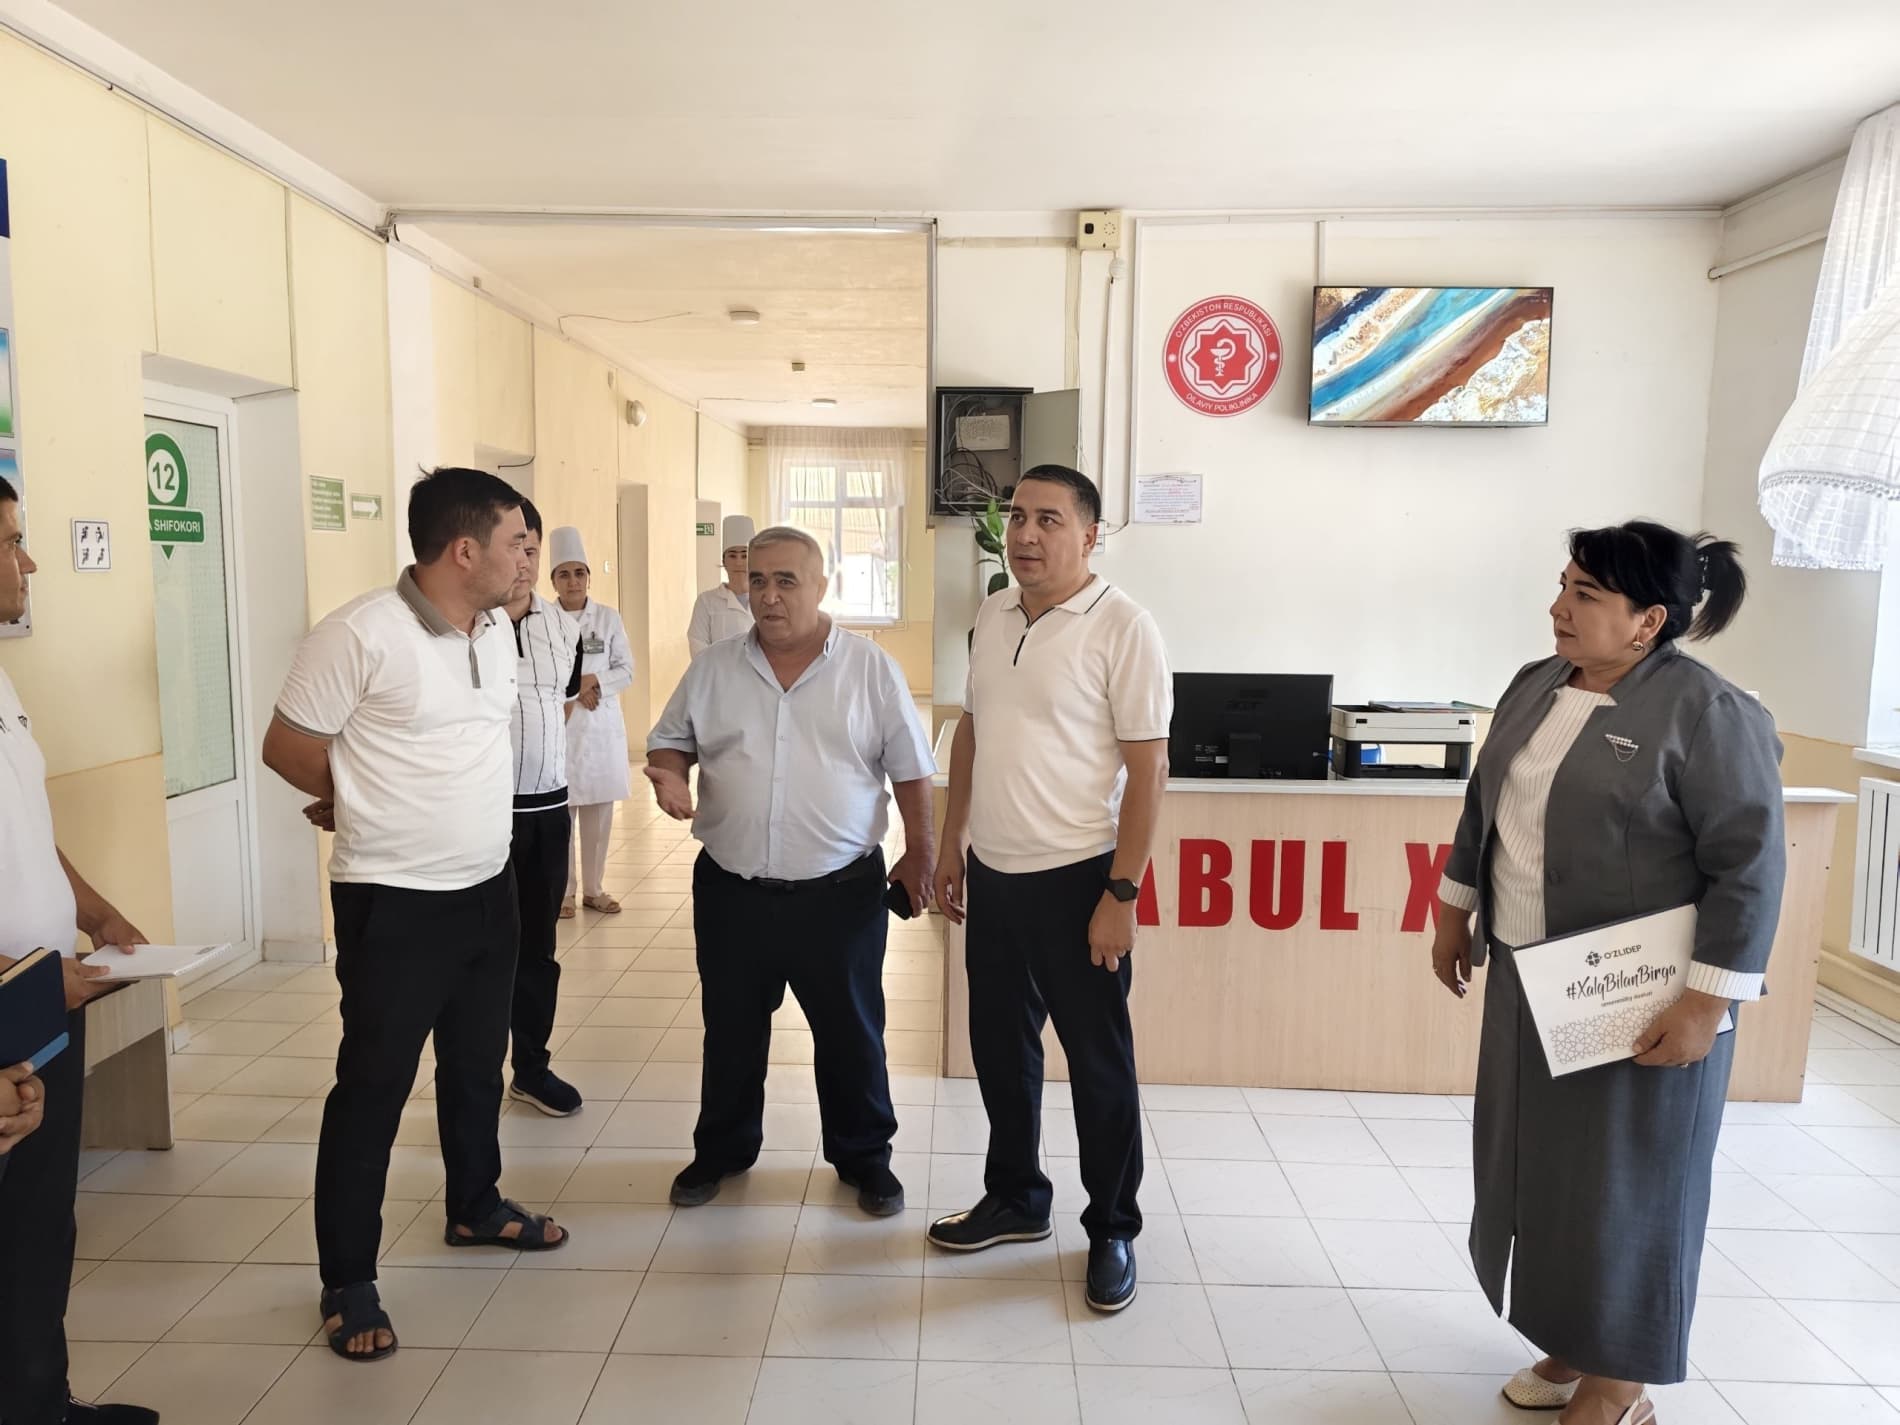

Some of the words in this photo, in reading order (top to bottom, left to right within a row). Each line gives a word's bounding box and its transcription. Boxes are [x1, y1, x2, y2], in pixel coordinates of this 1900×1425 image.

[1223, 302, 1273, 337] RESPUBLIKASI
[152, 461, 176, 491] 12
[154, 519, 201, 533] SHIFOKORI
[1566, 964, 1677, 1001] #XalqBilanBirga
